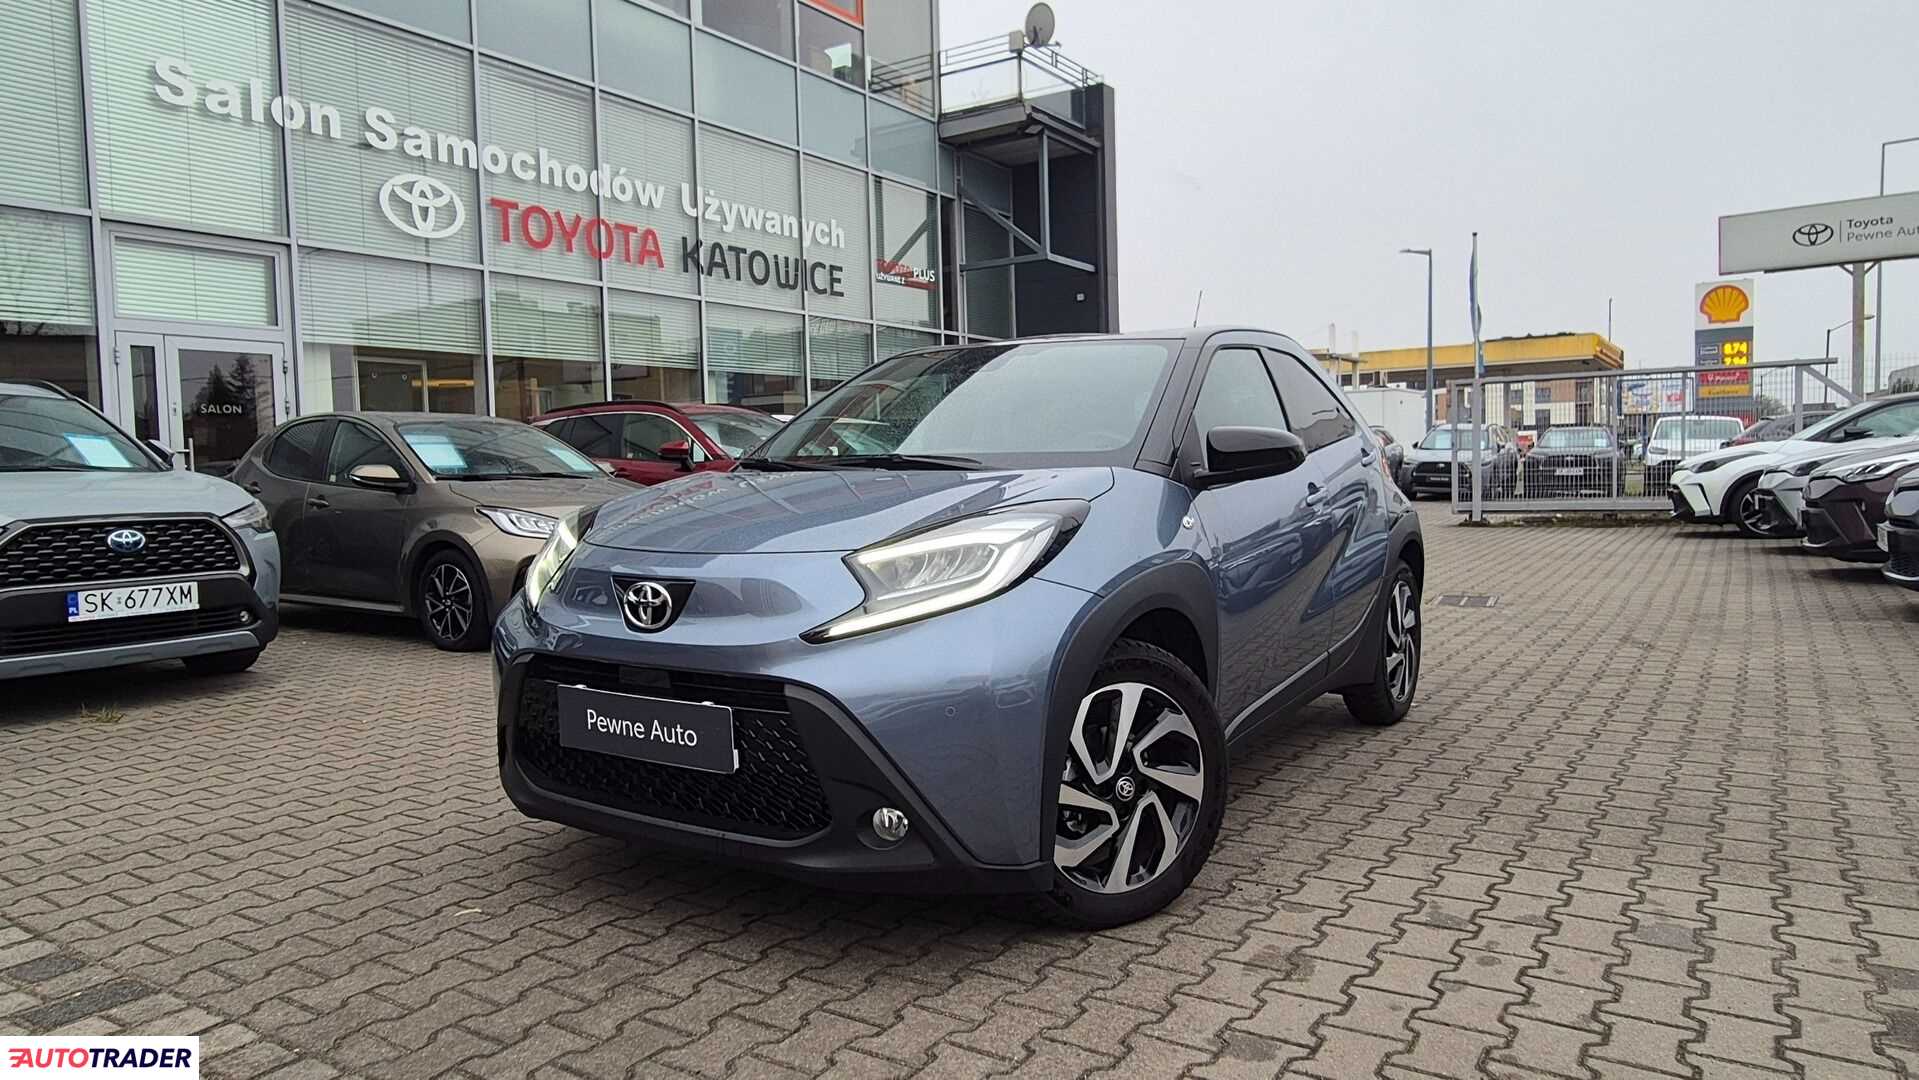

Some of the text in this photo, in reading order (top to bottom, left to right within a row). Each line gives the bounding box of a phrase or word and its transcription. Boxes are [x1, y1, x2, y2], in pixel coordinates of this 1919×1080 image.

[154, 56, 845, 249] Salon Samochodów Używanych
[1847, 216, 1894, 230] Toyota
[489, 197, 845, 297] TOYOTA KATOWICE
[1847, 231, 1893, 242] Pewne
[913, 267, 936, 282] PLUS
[200, 403, 242, 414] SALON
[85, 592, 113, 613] SK
[125, 585, 192, 609] 677XM
[586, 709, 697, 747] Pewne Auto
